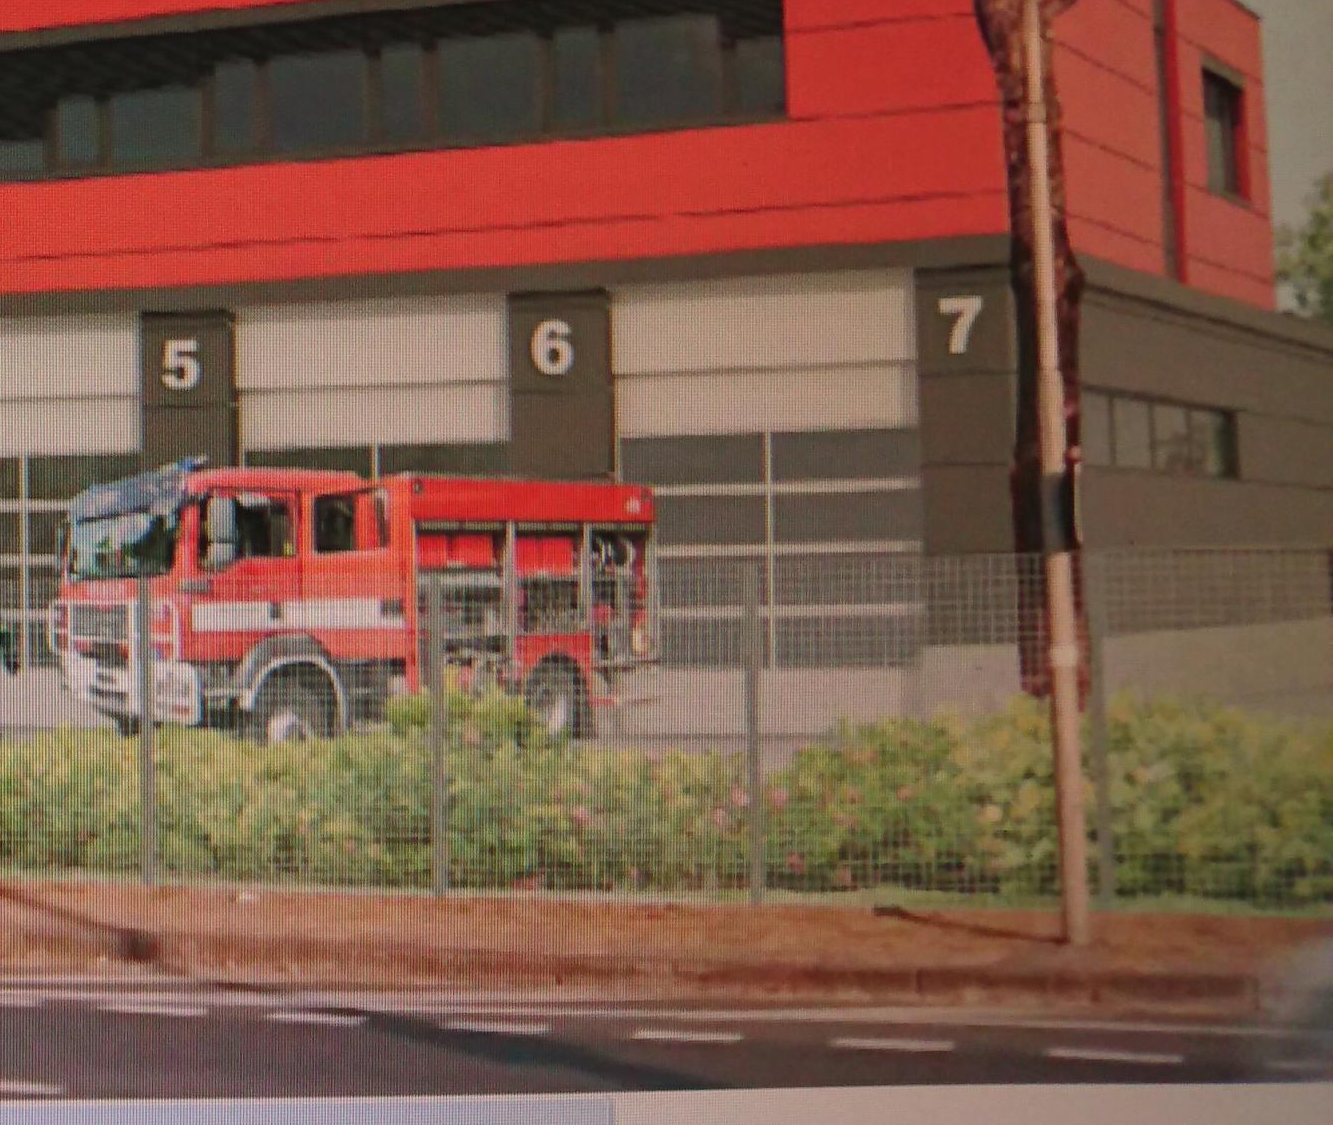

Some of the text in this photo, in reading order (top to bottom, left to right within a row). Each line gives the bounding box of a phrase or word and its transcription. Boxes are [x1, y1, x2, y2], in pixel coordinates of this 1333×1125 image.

[530, 318, 575, 376] 6
[937, 295, 984, 355] 7
[160, 337, 202, 391] 5
